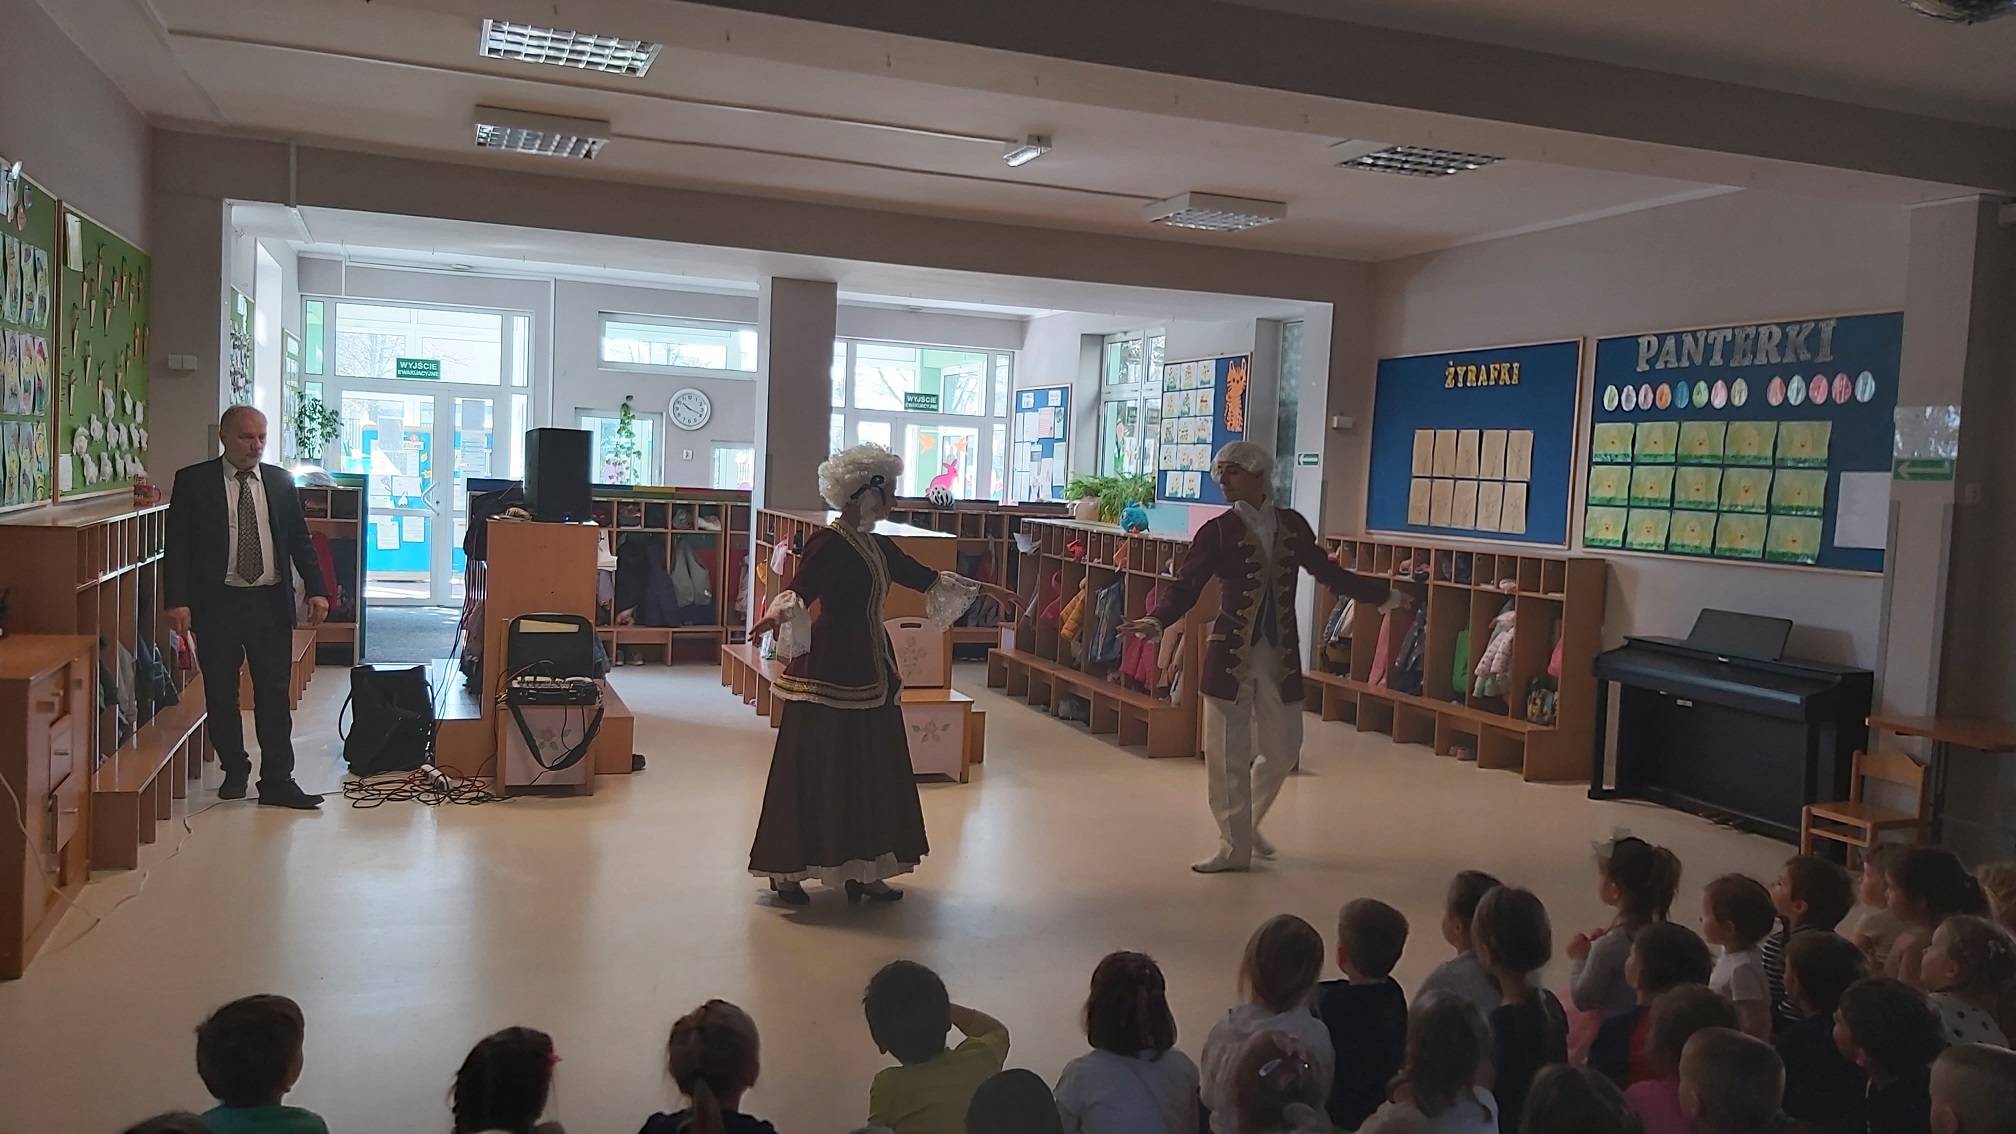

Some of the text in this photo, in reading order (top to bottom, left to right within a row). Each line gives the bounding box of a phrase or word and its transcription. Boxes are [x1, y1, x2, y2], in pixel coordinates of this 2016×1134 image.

[1636, 318, 1837, 372] PANTERKI
[400, 361, 438, 370] WYJŚCIE
[1444, 360, 1520, 388] ŻYRAFKI
[907, 395, 937, 403] WYJŚCIE
